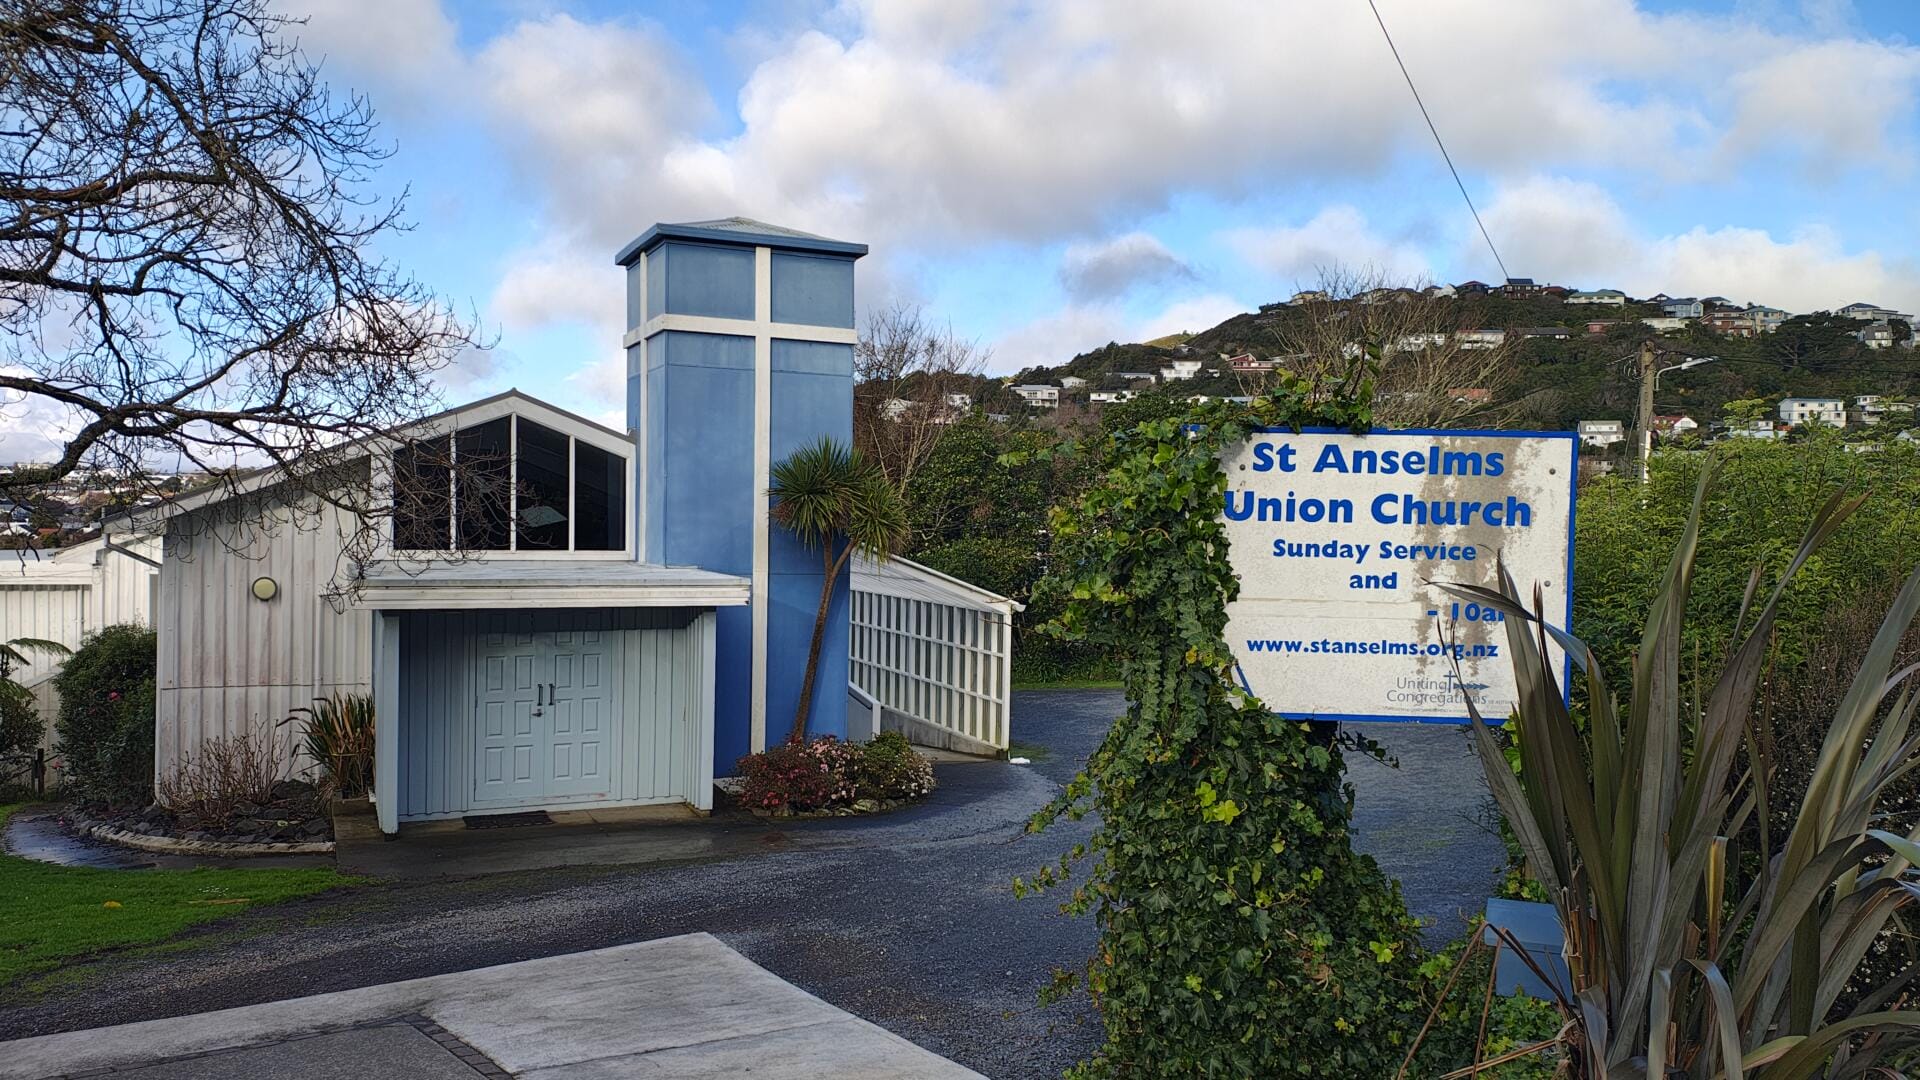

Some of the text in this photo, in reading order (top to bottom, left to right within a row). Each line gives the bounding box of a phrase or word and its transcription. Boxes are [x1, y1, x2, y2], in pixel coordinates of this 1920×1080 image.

[1252, 442, 1505, 477] St Anselms
[1223, 490, 1531, 527] Union Church
[1272, 538, 1477, 564] Sunday Service
[1349, 571, 1398, 590] and
[1246, 638, 1499, 661] www.stanselms.org.nz
[1396, 677, 1448, 694] Uniting
